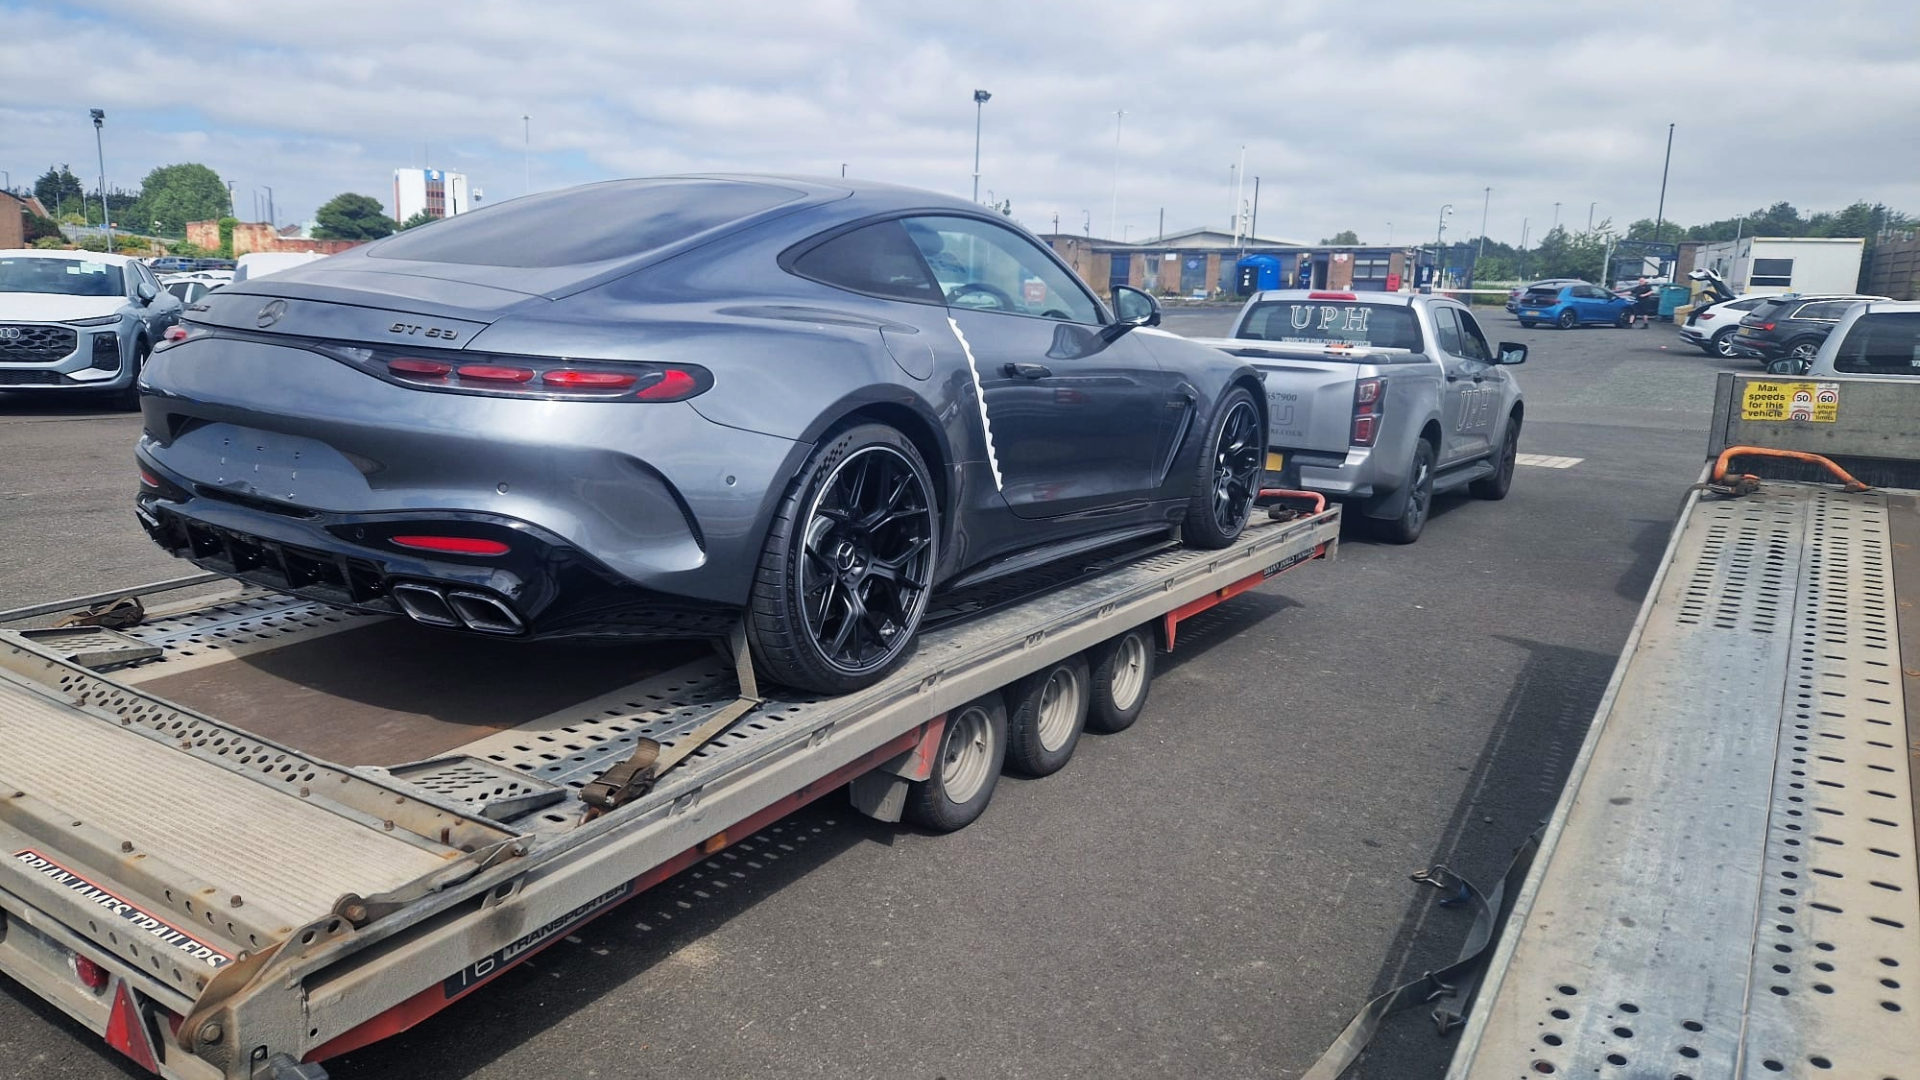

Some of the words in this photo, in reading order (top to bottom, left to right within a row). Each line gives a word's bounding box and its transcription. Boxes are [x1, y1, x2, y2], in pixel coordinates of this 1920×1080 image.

[1290, 304, 1373, 331] UPH
[388, 322, 422, 335] GT
[424, 327, 459, 340] 63
[1748, 393, 1786, 401] speeds
[1796, 394, 1809, 402] 50
[1820, 395, 1834, 403] 60
[1749, 401, 1762, 409] for
[1748, 410, 1783, 418] vehicle
[1794, 413, 1807, 421] 60
[507, 883, 625, 955] TRANSPORTER
